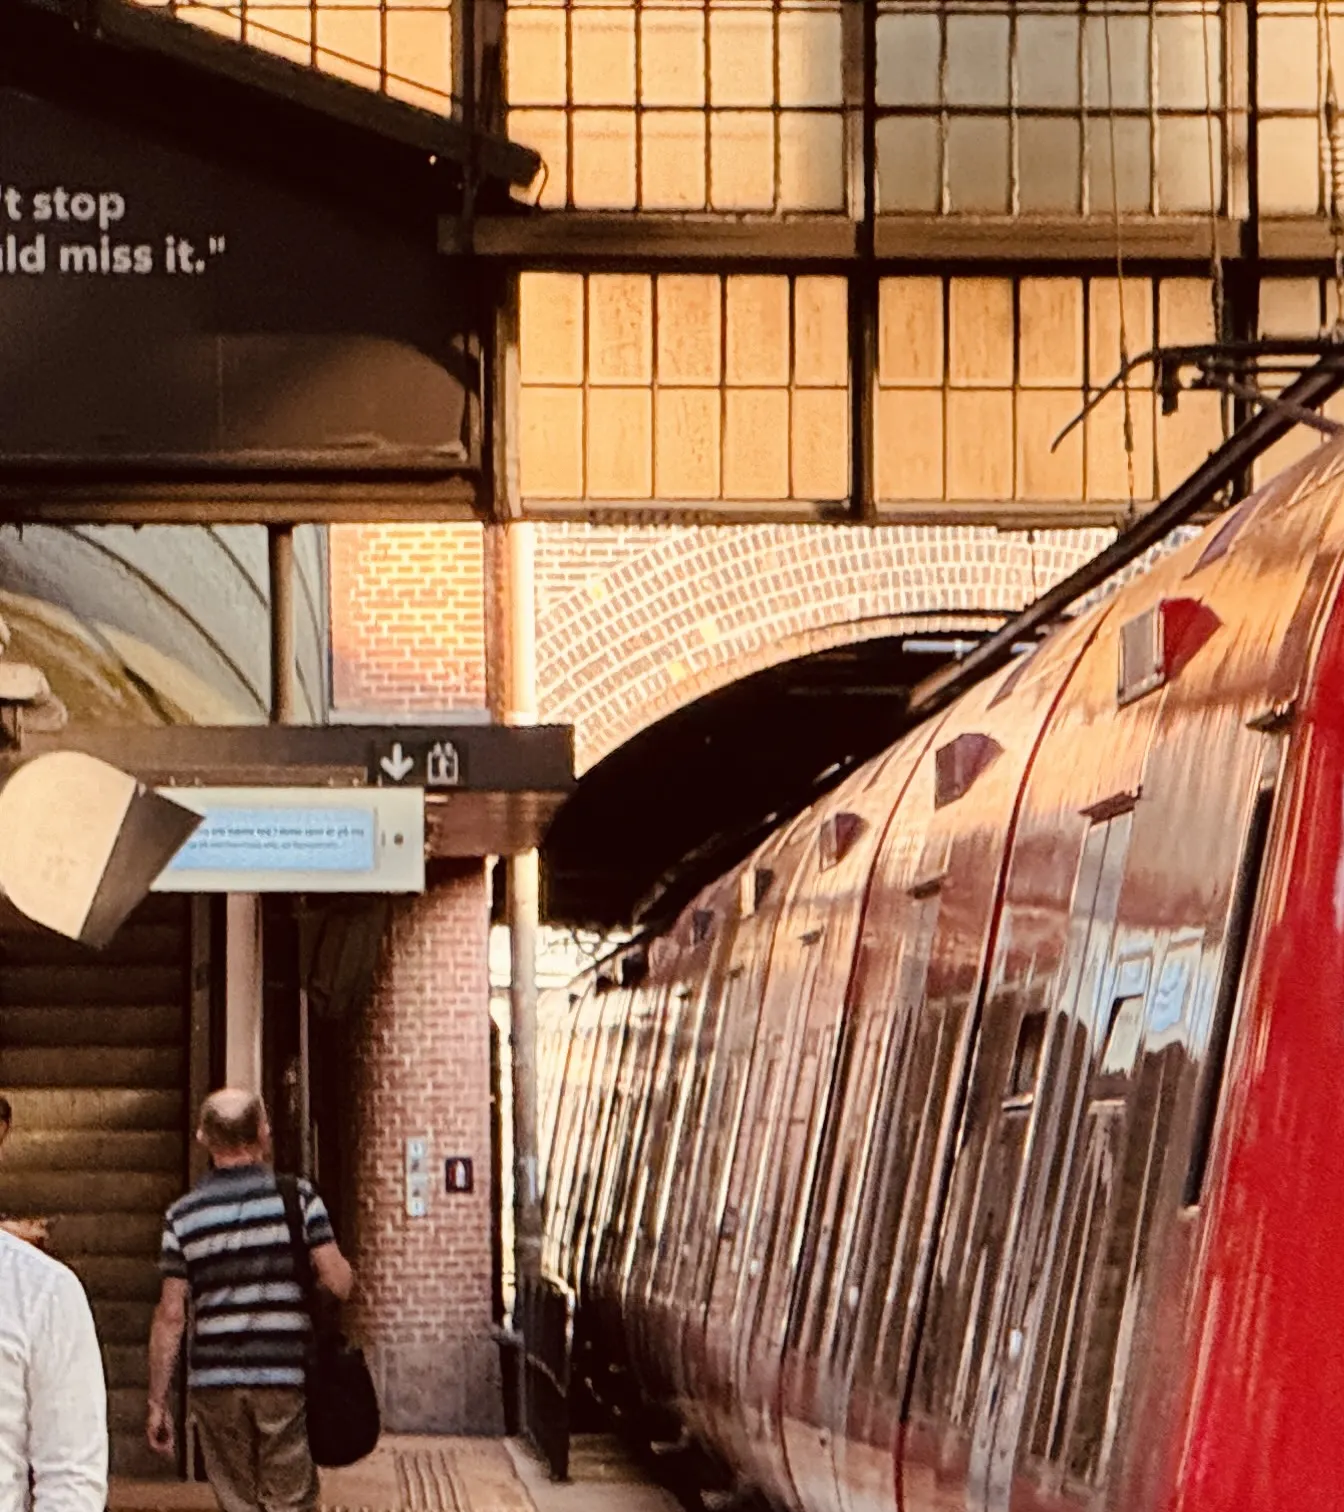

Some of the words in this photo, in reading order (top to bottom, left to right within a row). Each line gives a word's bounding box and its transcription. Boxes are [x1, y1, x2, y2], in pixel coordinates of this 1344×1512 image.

[33, 186, 125, 231] stop
[0, 233, 46, 274] ld
[59, 234, 152, 275] miss
[165, 234, 226, 274] it."
